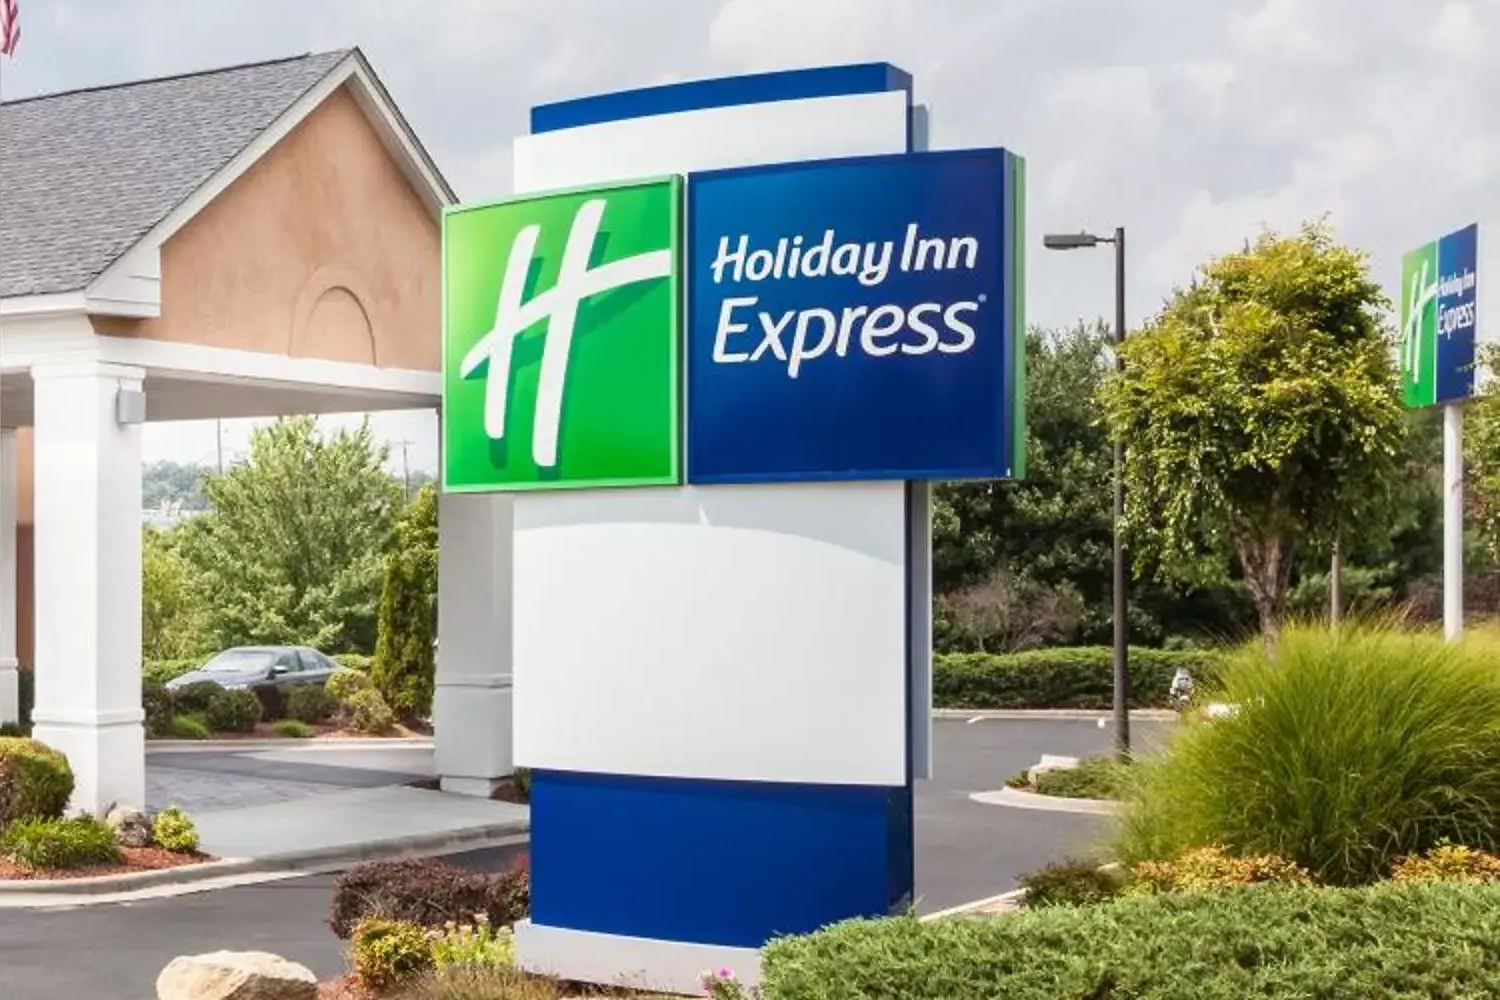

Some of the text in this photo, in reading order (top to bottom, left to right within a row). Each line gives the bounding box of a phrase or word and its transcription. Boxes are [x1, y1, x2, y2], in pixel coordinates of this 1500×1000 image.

[710, 223, 979, 287] Holiday Inn
[712, 296, 980, 379] Express
[1437, 301, 1475, 341] Express
